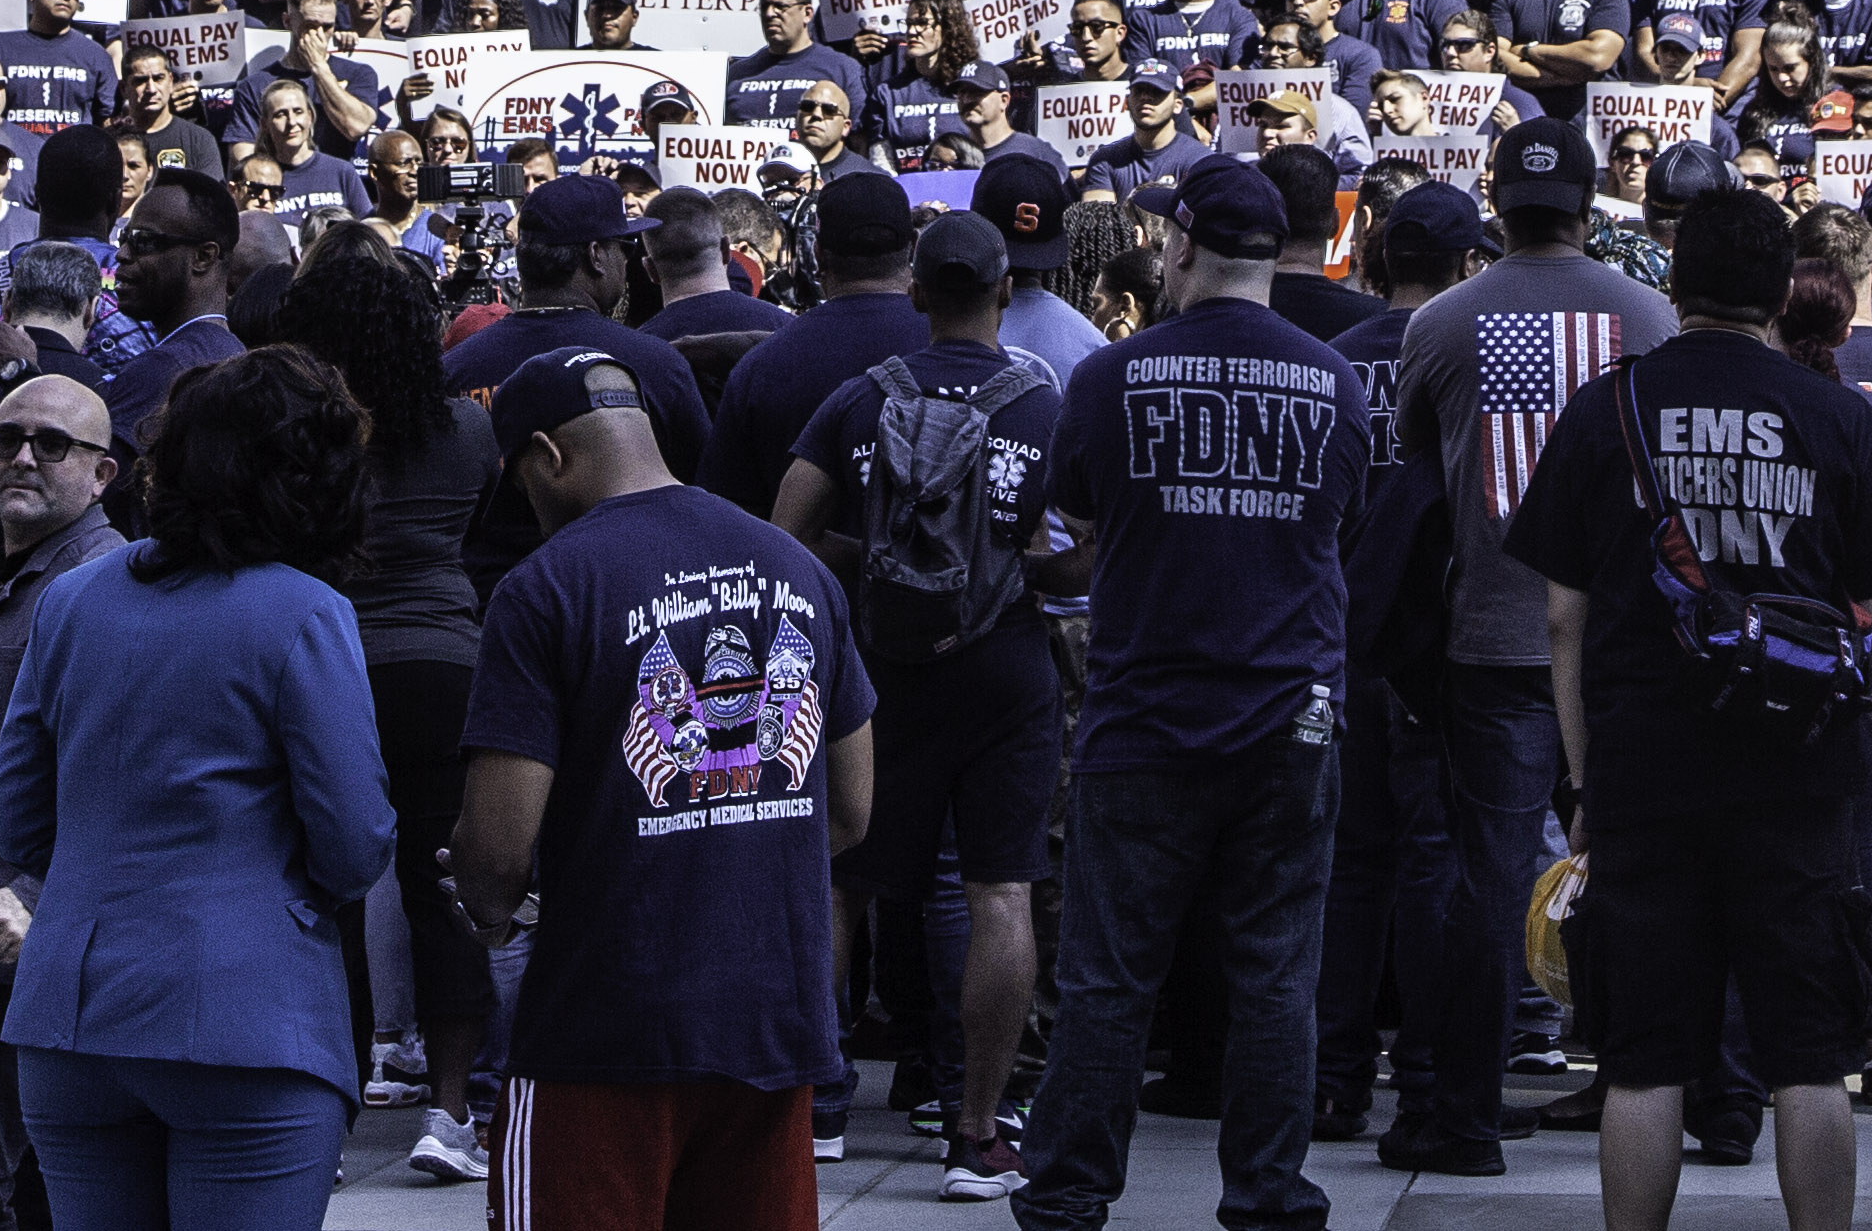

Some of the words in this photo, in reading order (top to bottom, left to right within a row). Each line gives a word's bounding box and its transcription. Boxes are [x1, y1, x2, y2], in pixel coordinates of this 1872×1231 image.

[984, 17, 1020, 43] FOR
[8, 65, 56, 79] FDNY
[58, 68, 87, 82] EMS
[504, 97, 555, 115] FDNY
[1592, 96, 1658, 118] EQUAL
[1664, 100, 1704, 120] PAY
[503, 117, 553, 134] EMS
[1127, 356, 1221, 384] COUNTER
[1226, 357, 1335, 398] TERRORISM
[1124, 387, 1336, 489] FDNY
[1660, 407, 1784, 458] EMS
[1160, 486, 1224, 515] TASK
[1229, 489, 1305, 521] FORCE
[1743, 459, 1817, 517] UNION
[665, 573, 676, 586] In
[680, 570, 707, 584] Loving
[709, 565, 744, 579] Memory
[746, 560, 755, 576] of
[625, 606, 650, 645] Lt.
[653, 591, 712, 628] William
[712, 578, 767, 619] "Billy"
[773, 581, 815, 618] Moore
[773, 677, 800, 690] 35
[689, 765, 762, 803] FDNY
[638, 810, 707, 836] EMERGENCY
[710, 804, 755, 825] MEDICAL
[756, 798, 813, 818] SERVICES
